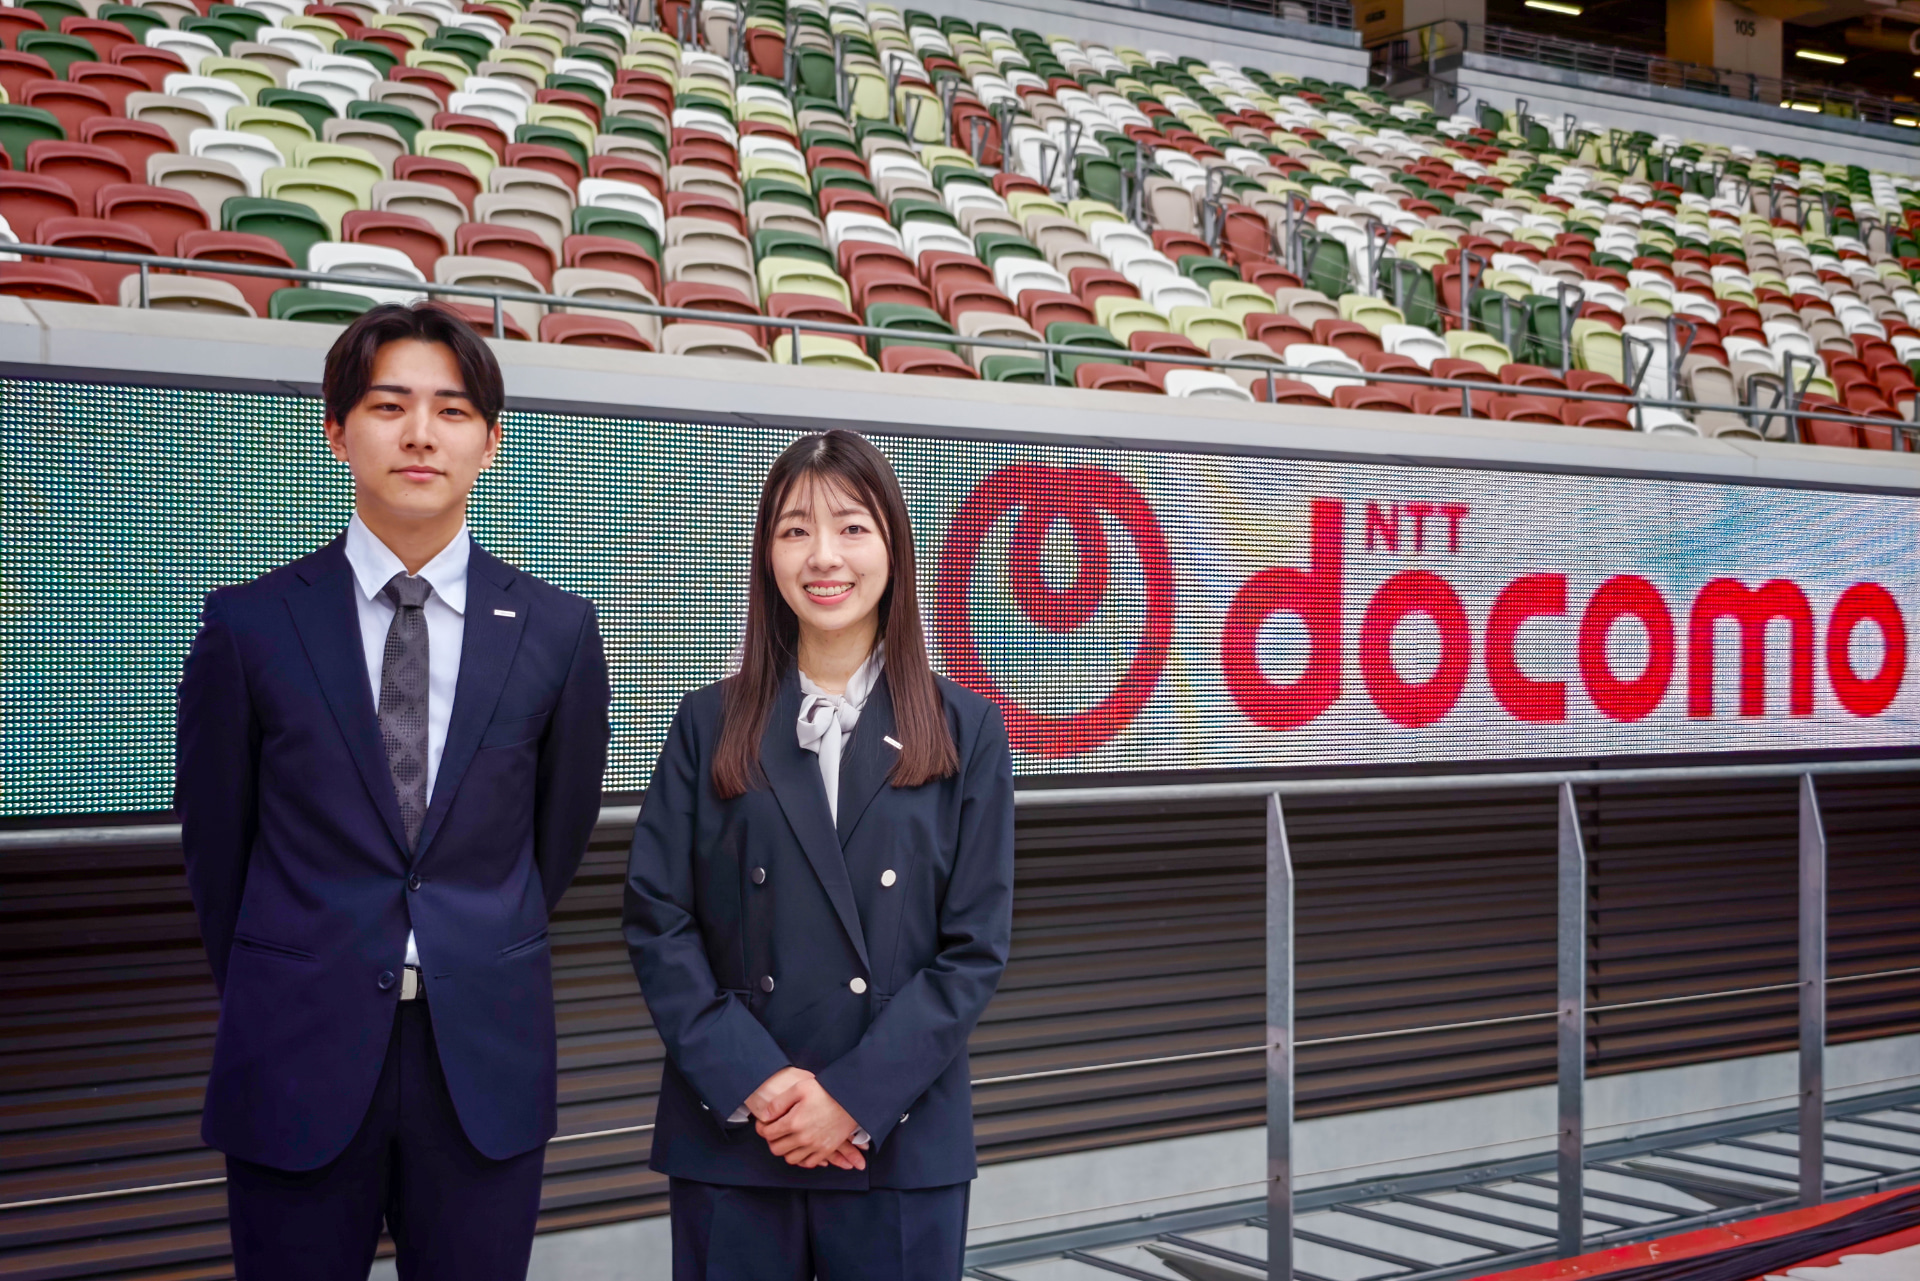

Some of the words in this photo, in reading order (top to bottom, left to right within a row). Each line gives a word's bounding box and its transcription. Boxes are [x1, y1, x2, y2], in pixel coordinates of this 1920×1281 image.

[1734, 18, 1756, 37] 105
[1365, 500, 1470, 552] NTT
[1222, 497, 1905, 730] docomo
